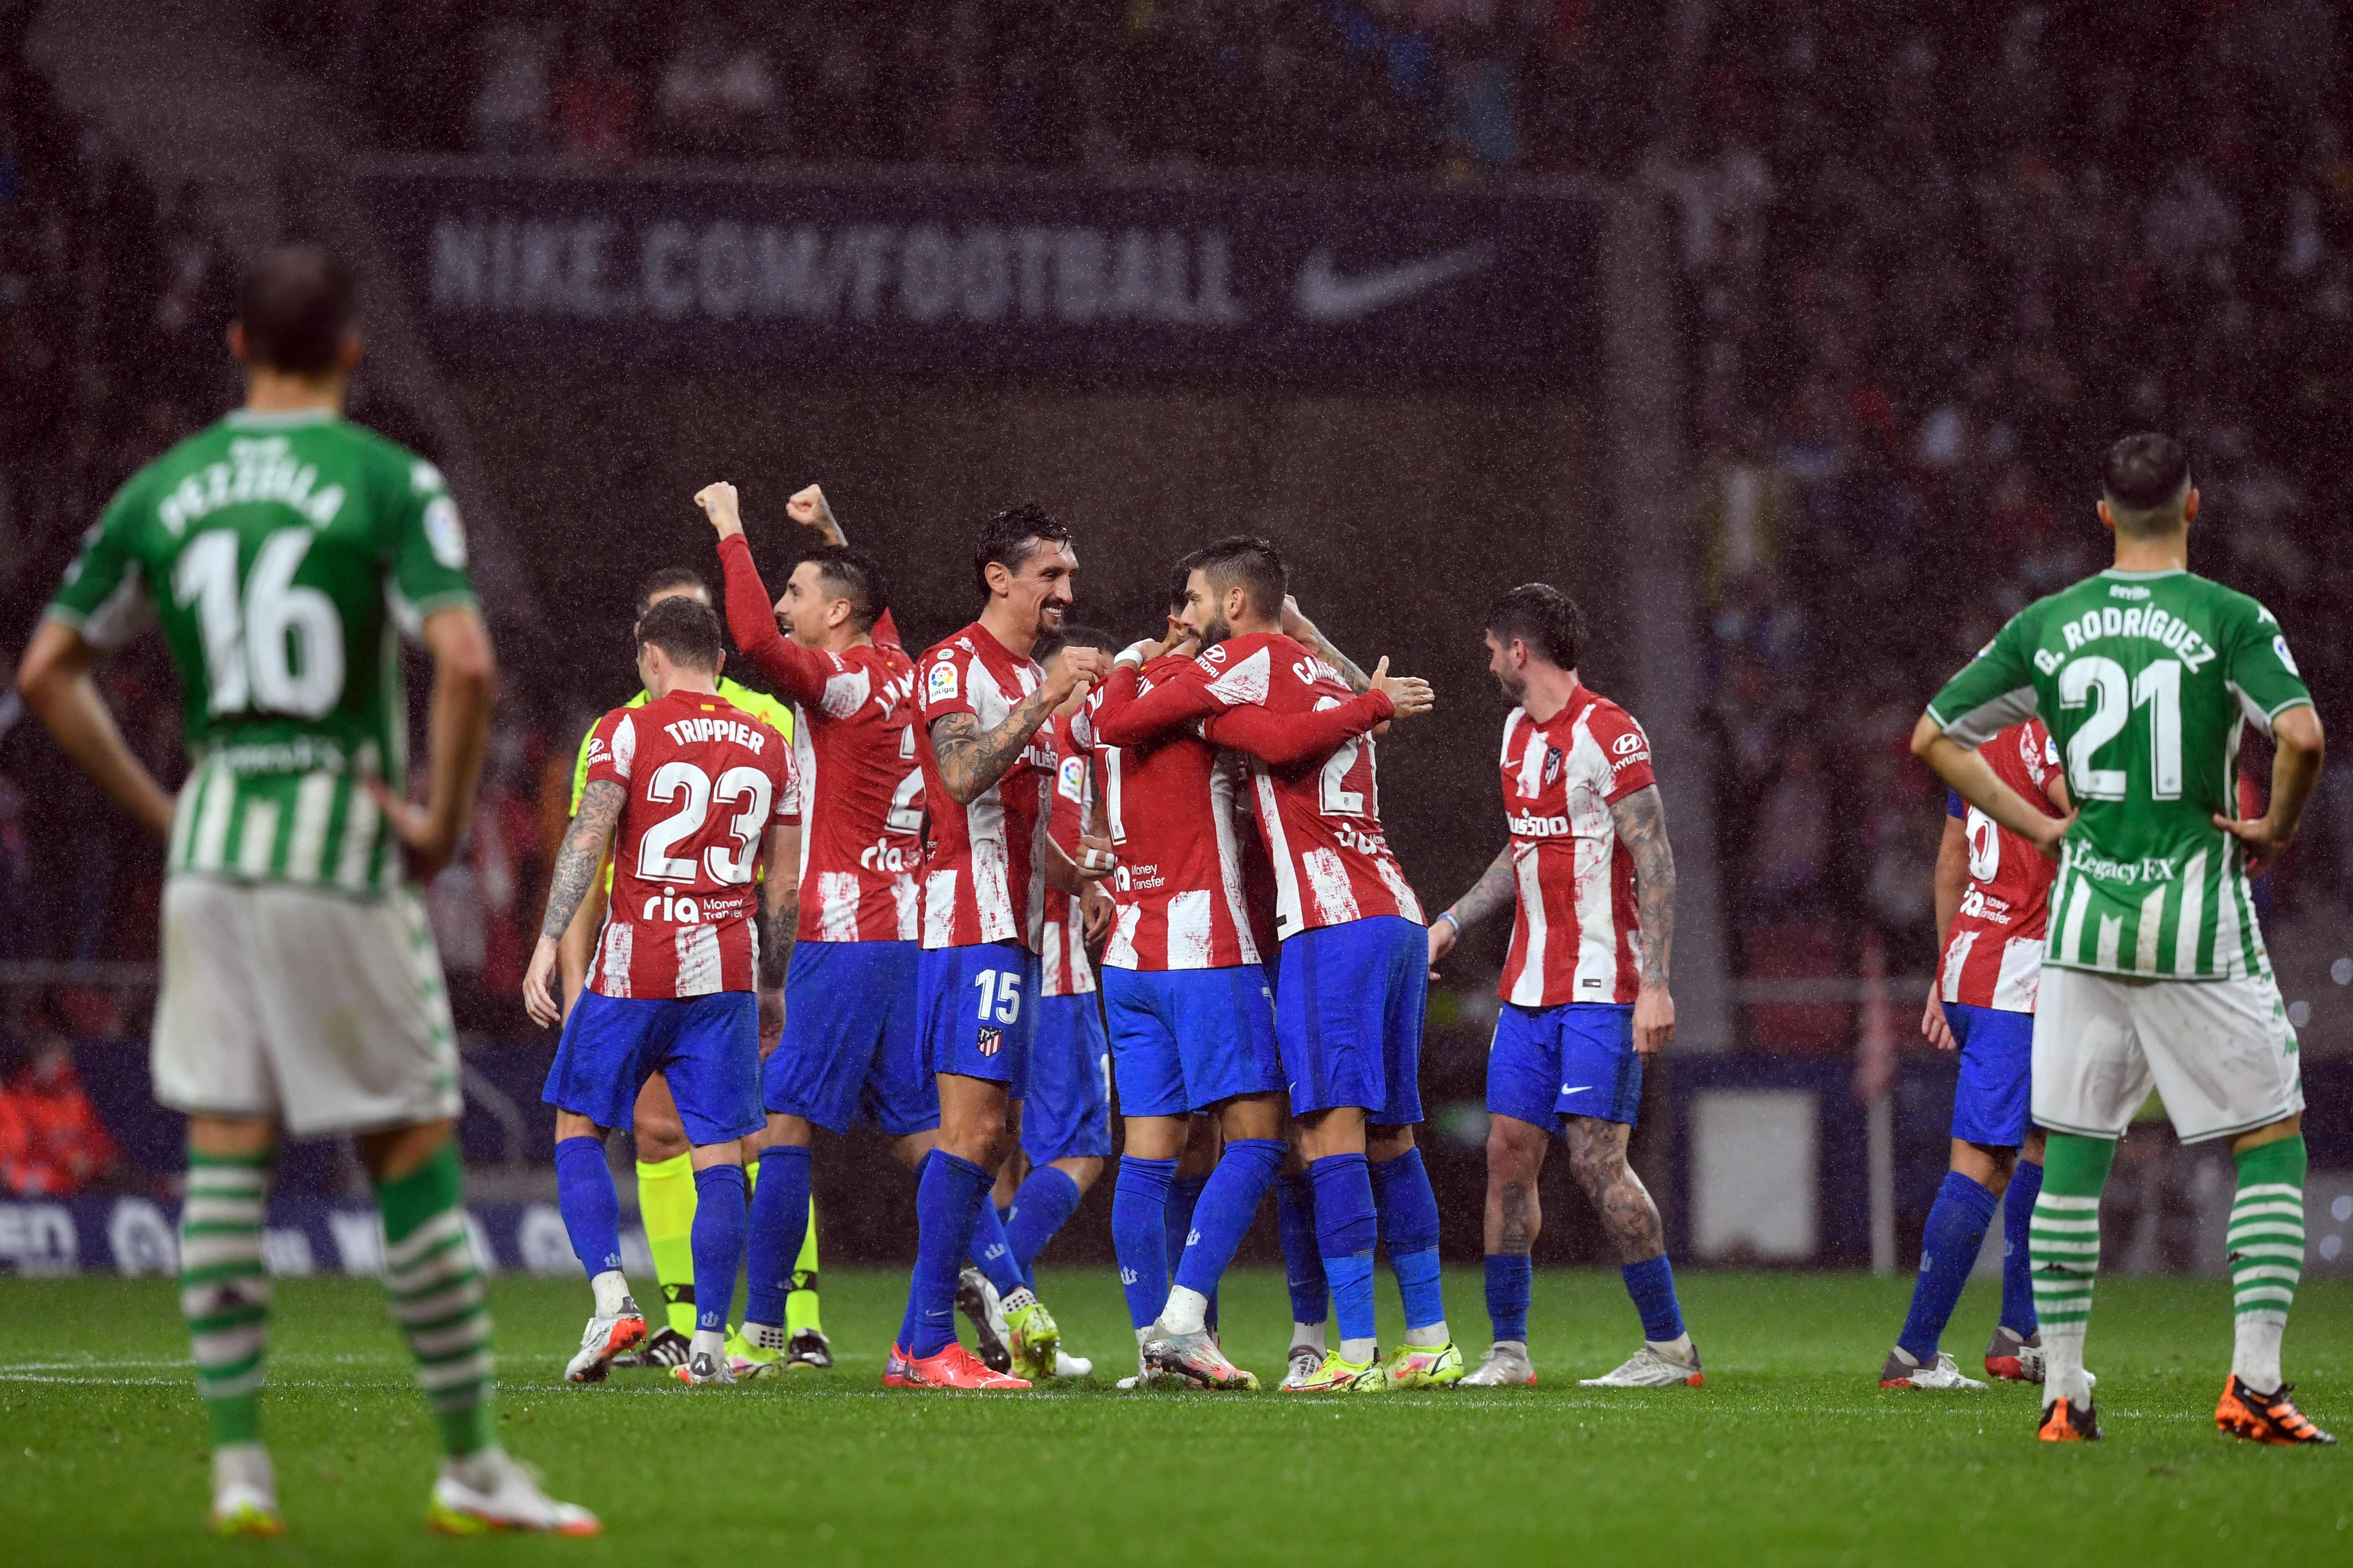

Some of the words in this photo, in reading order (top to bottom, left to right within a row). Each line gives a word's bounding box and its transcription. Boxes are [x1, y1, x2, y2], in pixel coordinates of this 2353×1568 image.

[173, 526, 346, 720] 16
[2062, 602, 2216, 675] RODRÍGUEZ
[932, 687, 954, 697] LaLiga
[664, 718, 765, 756] TRIPPIER
[2059, 656, 2182, 801] 21
[635, 761, 773, 886] 23
[861, 837, 904, 872] ria
[1131, 864, 1158, 875] Money
[1132, 875, 1166, 890] Transfer
[643, 886, 700, 923] ria
[703, 899, 743, 910] Money
[975, 969, 1021, 1025] 15
